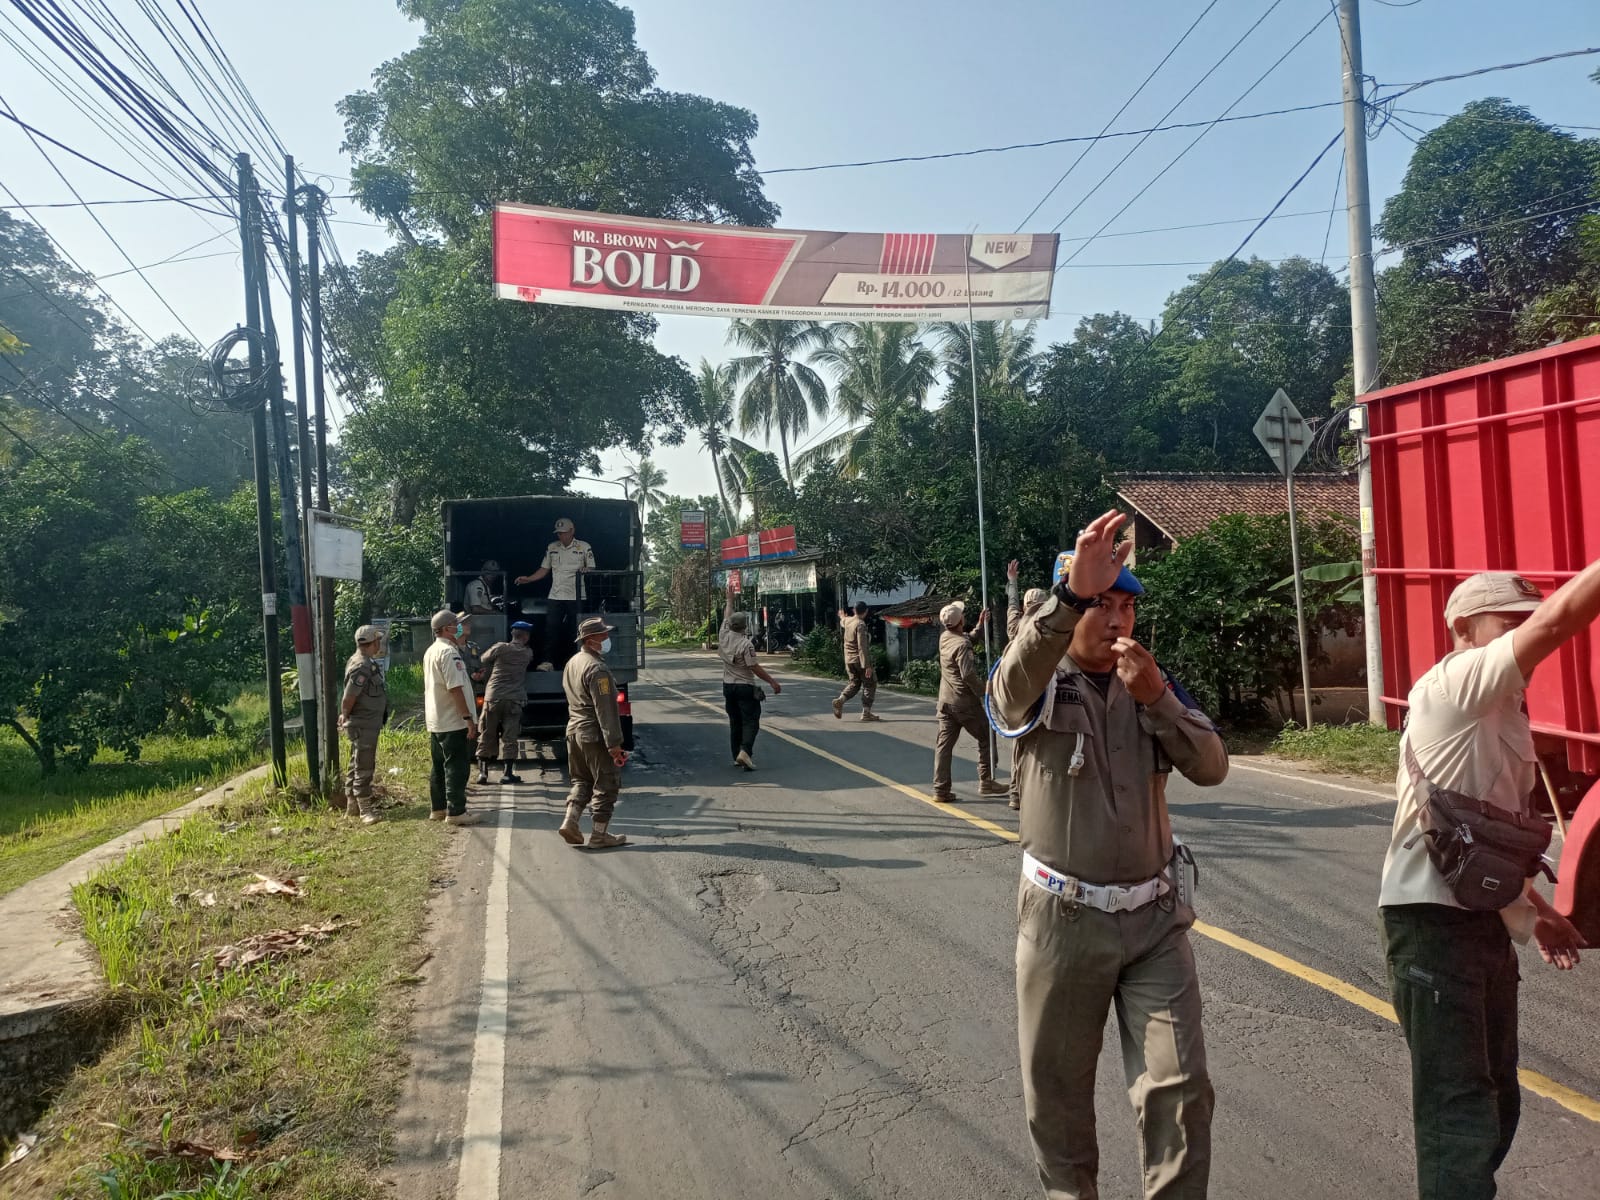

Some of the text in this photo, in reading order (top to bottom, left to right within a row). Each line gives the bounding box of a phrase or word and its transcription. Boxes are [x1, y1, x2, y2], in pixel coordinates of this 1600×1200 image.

[573, 229, 657, 249] MR. BROWN
[984, 241, 1018, 254] NEW
[572, 245, 701, 291] BOLD
[856, 280, 878, 295] Rp.
[881, 281, 946, 298] 14.000
